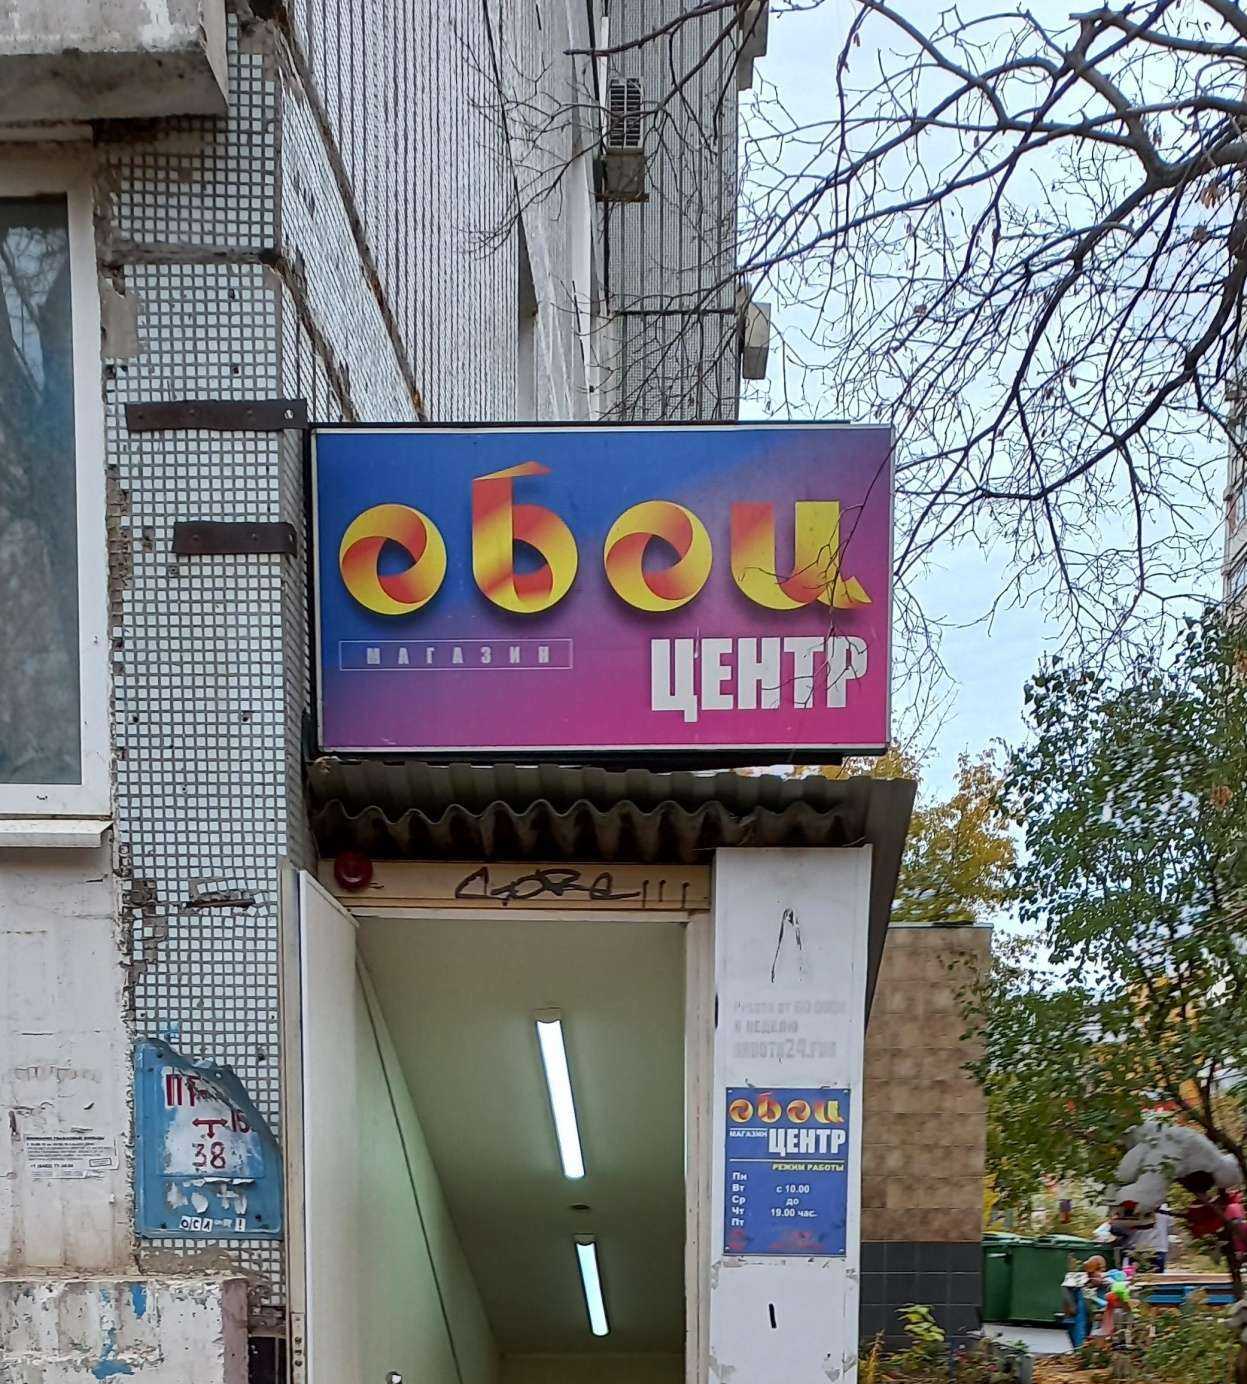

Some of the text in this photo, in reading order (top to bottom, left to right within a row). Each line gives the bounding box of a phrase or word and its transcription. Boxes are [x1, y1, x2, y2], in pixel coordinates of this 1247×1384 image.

[367, 646, 549, 665] МАГАЗИН
[651, 636, 868, 722] ЦЕНТР
[769, 1128, 846, 1156] ЦЕНТР
[192, 1141, 226, 1169] 38
[772, 1163, 805, 1171] РЕЖИМ
[732, 1172, 747, 1180] Пн
[732, 1183, 745, 1192] Вт
[785, 1184, 810, 1193] 10.00
[732, 1195, 746, 1205] Ср
[732, 1206, 745, 1215] Чт
[771, 1208, 796, 1217] 19.00
[731, 1218, 745, 1226] Пт
